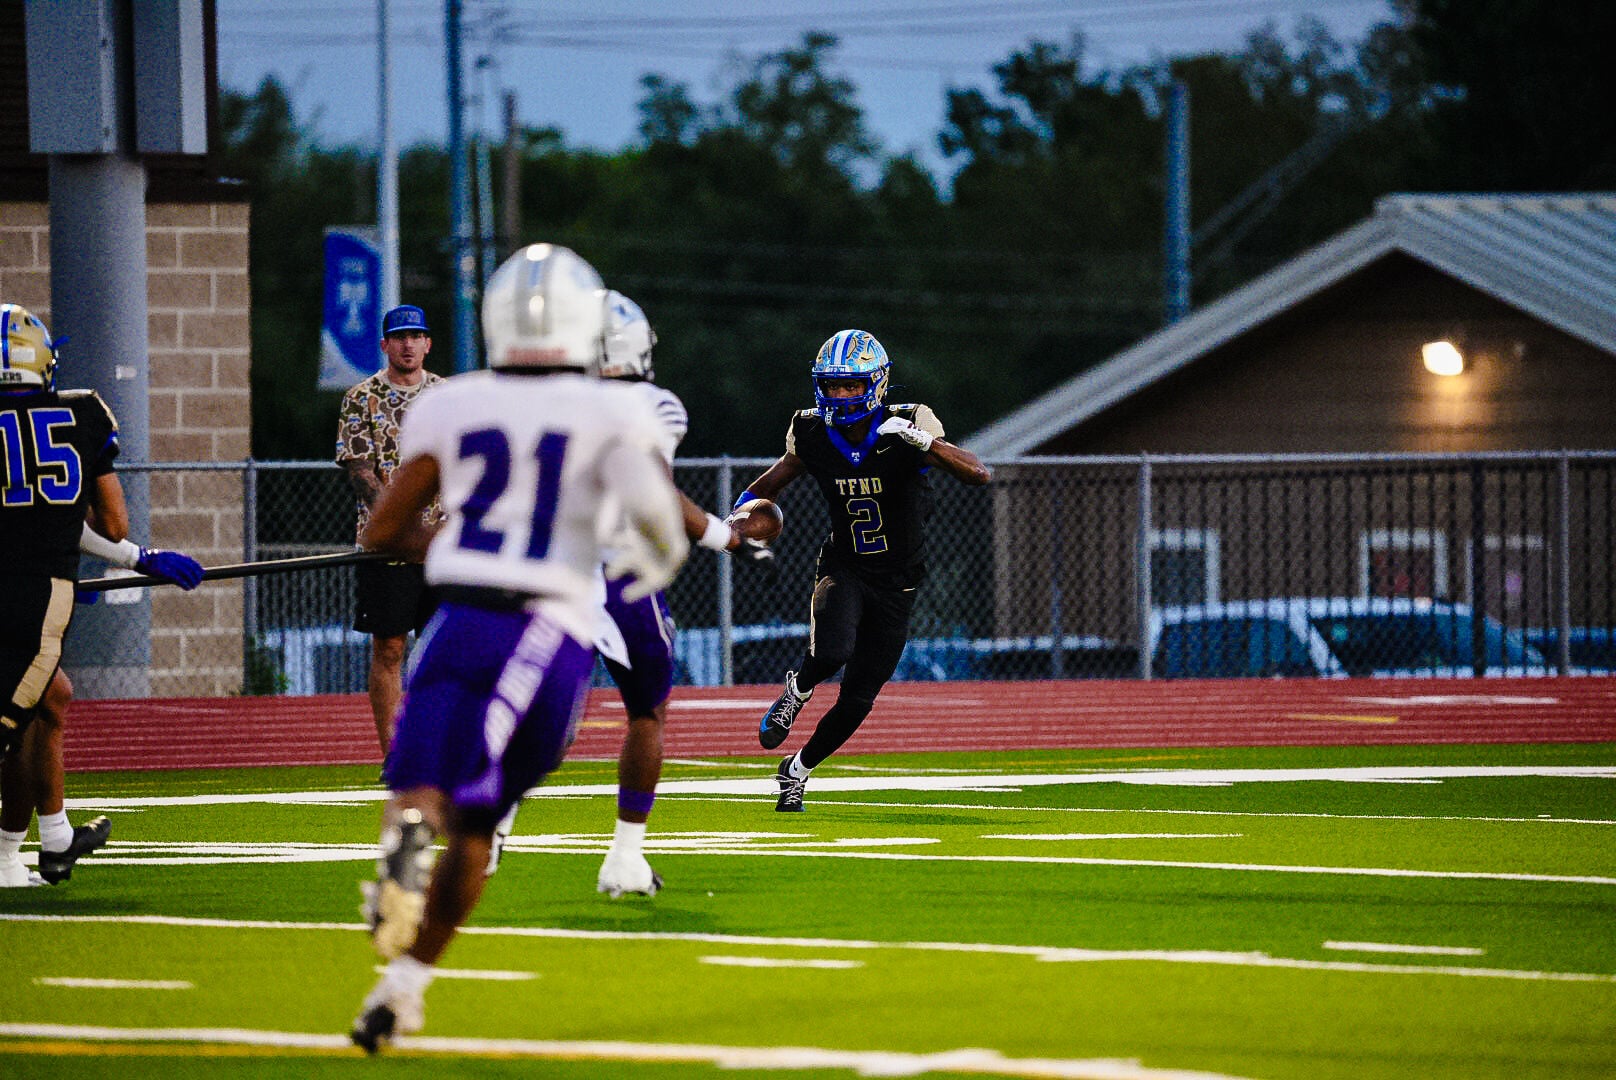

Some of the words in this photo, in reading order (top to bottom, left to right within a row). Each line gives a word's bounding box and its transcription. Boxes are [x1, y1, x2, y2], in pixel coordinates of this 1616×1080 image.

[0, 408, 82, 506] 15
[457, 427, 570, 562] 21
[835, 477, 883, 495] TFND
[846, 497, 888, 554] 2
